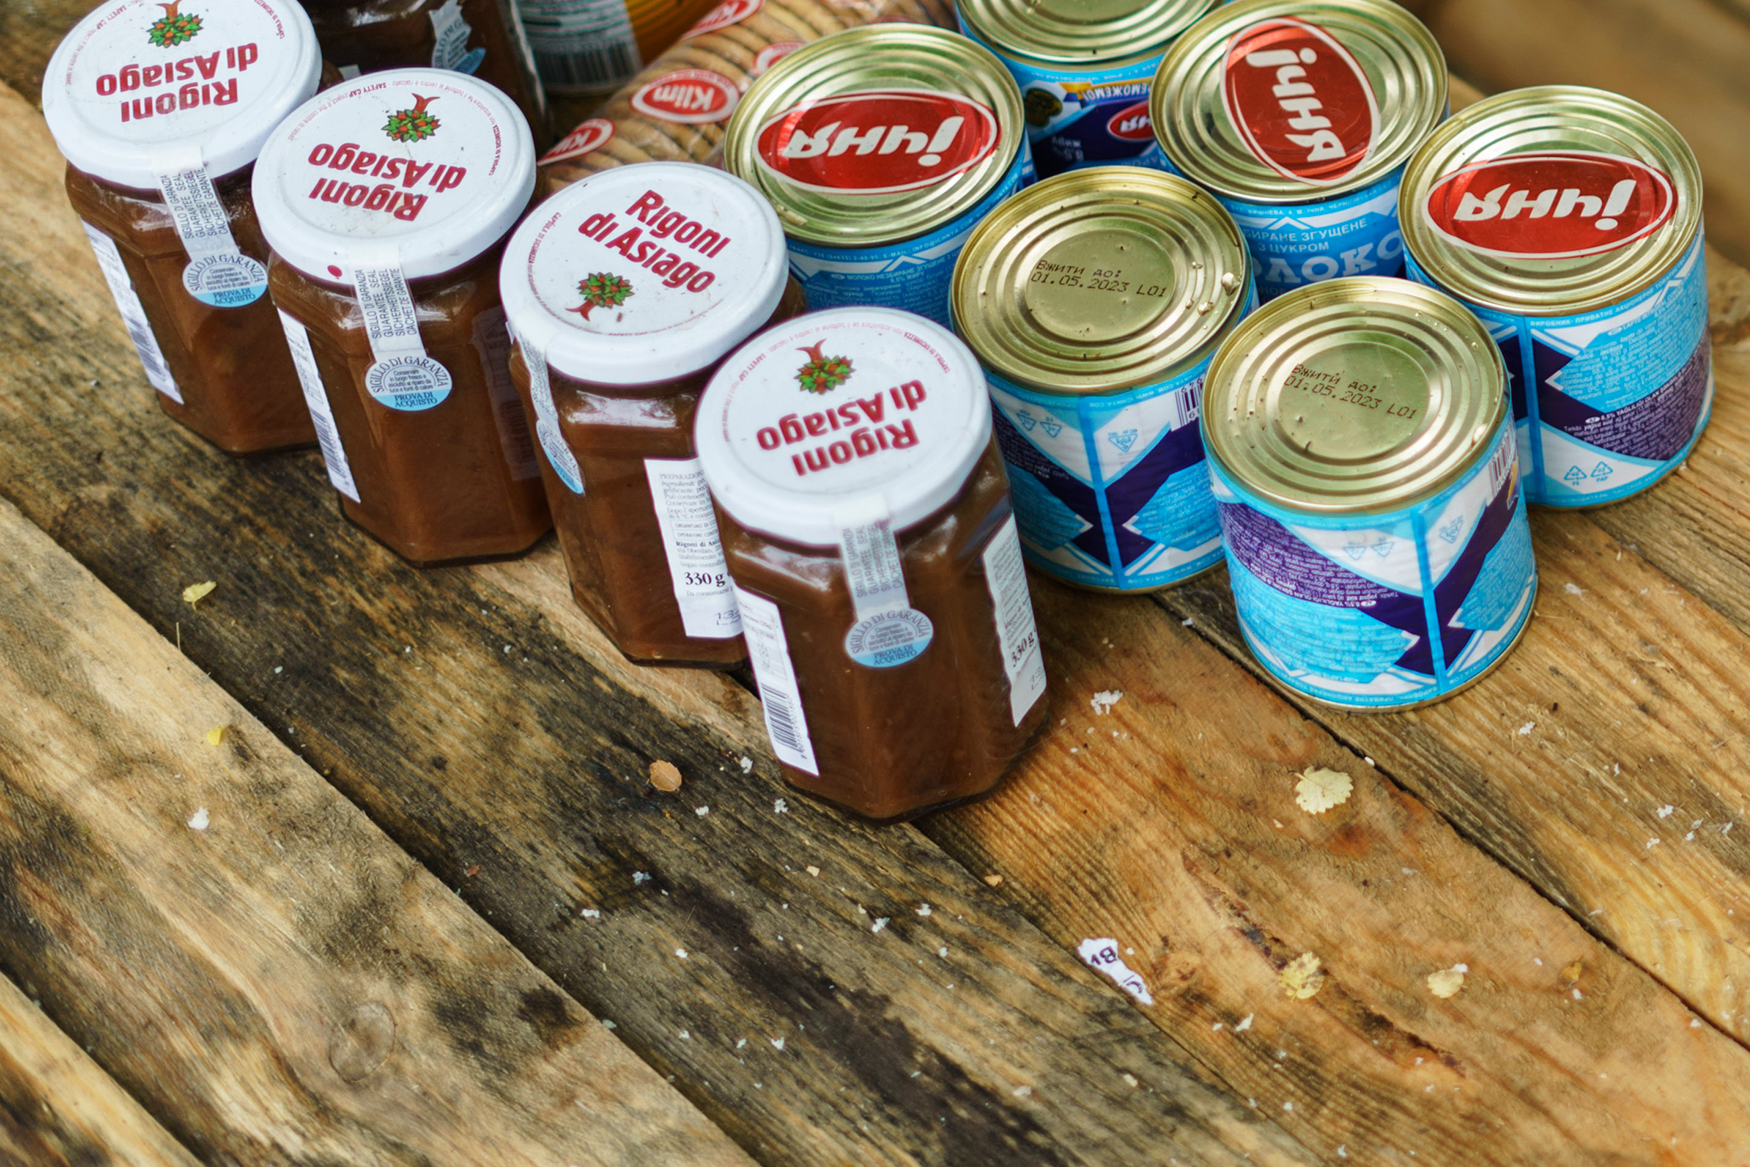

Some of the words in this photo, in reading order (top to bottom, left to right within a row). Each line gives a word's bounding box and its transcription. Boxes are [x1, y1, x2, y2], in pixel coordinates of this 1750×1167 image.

[226, 42, 257, 70] di
[95, 51, 219, 96] Asiago
[363, 82, 386, 92] SAFETY
[120, 77, 237, 121] Rigoni
[349, 89, 360, 97] CAP
[652, 84, 714, 110] Klim
[307, 143, 433, 187] Asiago
[428, 164, 466, 192] di
[161, 175, 179, 203] GARANZIA
[172, 172, 186, 190] SEAL
[308, 177, 428, 221] Rigoni
[178, 212, 193, 239] SIGILLO
[180, 195, 205, 236] GUARANTEE
[210, 208, 227, 234] CACHET
[625, 189, 730, 259] Rigoni
[1244, 228, 1297, 241] БИРАНЕ
[1301, 217, 1367, 241] ЗГУЩЕНЕ
[577, 212, 619, 242] di
[604, 228, 716, 293] Asiago
[1268, 241, 1329, 252] ЦУКРОМ
[187, 261, 205, 291] SIGILLO
[203, 255, 216, 265] DI
[218, 254, 264, 282] GARANZIA
[354, 269, 371, 301] GARANZIA
[366, 269, 379, 287] SEAL
[389, 267, 406, 295] GARANTIE
[1031, 271, 1129, 292] 01.05.2023
[1136, 284, 1166, 297] L01
[1092, 268, 1121, 278] до:
[212, 290, 240, 298] PROVA
[214, 294, 255, 304] ACQUISTO
[378, 268, 405, 336] SICHERHEITSSIEGEL
[398, 295, 409, 304] DE
[366, 310, 381, 338] SIGILLO
[372, 292, 393, 336] GUARANTEE
[401, 305, 417, 334] CACHET
[370, 362, 389, 392] SIGILLO
[388, 357, 402, 367] DI
[404, 356, 448, 386] GARANZIA
[1348, 380, 1376, 393] до:
[395, 397, 437, 406] ACQUISTO
[888, 379, 926, 411] di
[1284, 374, 1381, 410] 01.05.2023
[1386, 402, 1417, 419] L01
[755, 391, 882, 450] Asiago
[791, 418, 919, 476] Rigoni
[683, 572, 711, 585] 330
[715, 572, 725, 587] g
[850, 620, 872, 653] SIGILLO
[870, 613, 884, 623] DI
[886, 610, 930, 637] GARANZIA
[873, 647, 902, 658] PROVA
[874, 649, 916, 665] ACQUISTO
[1010, 638, 1027, 667] 330
